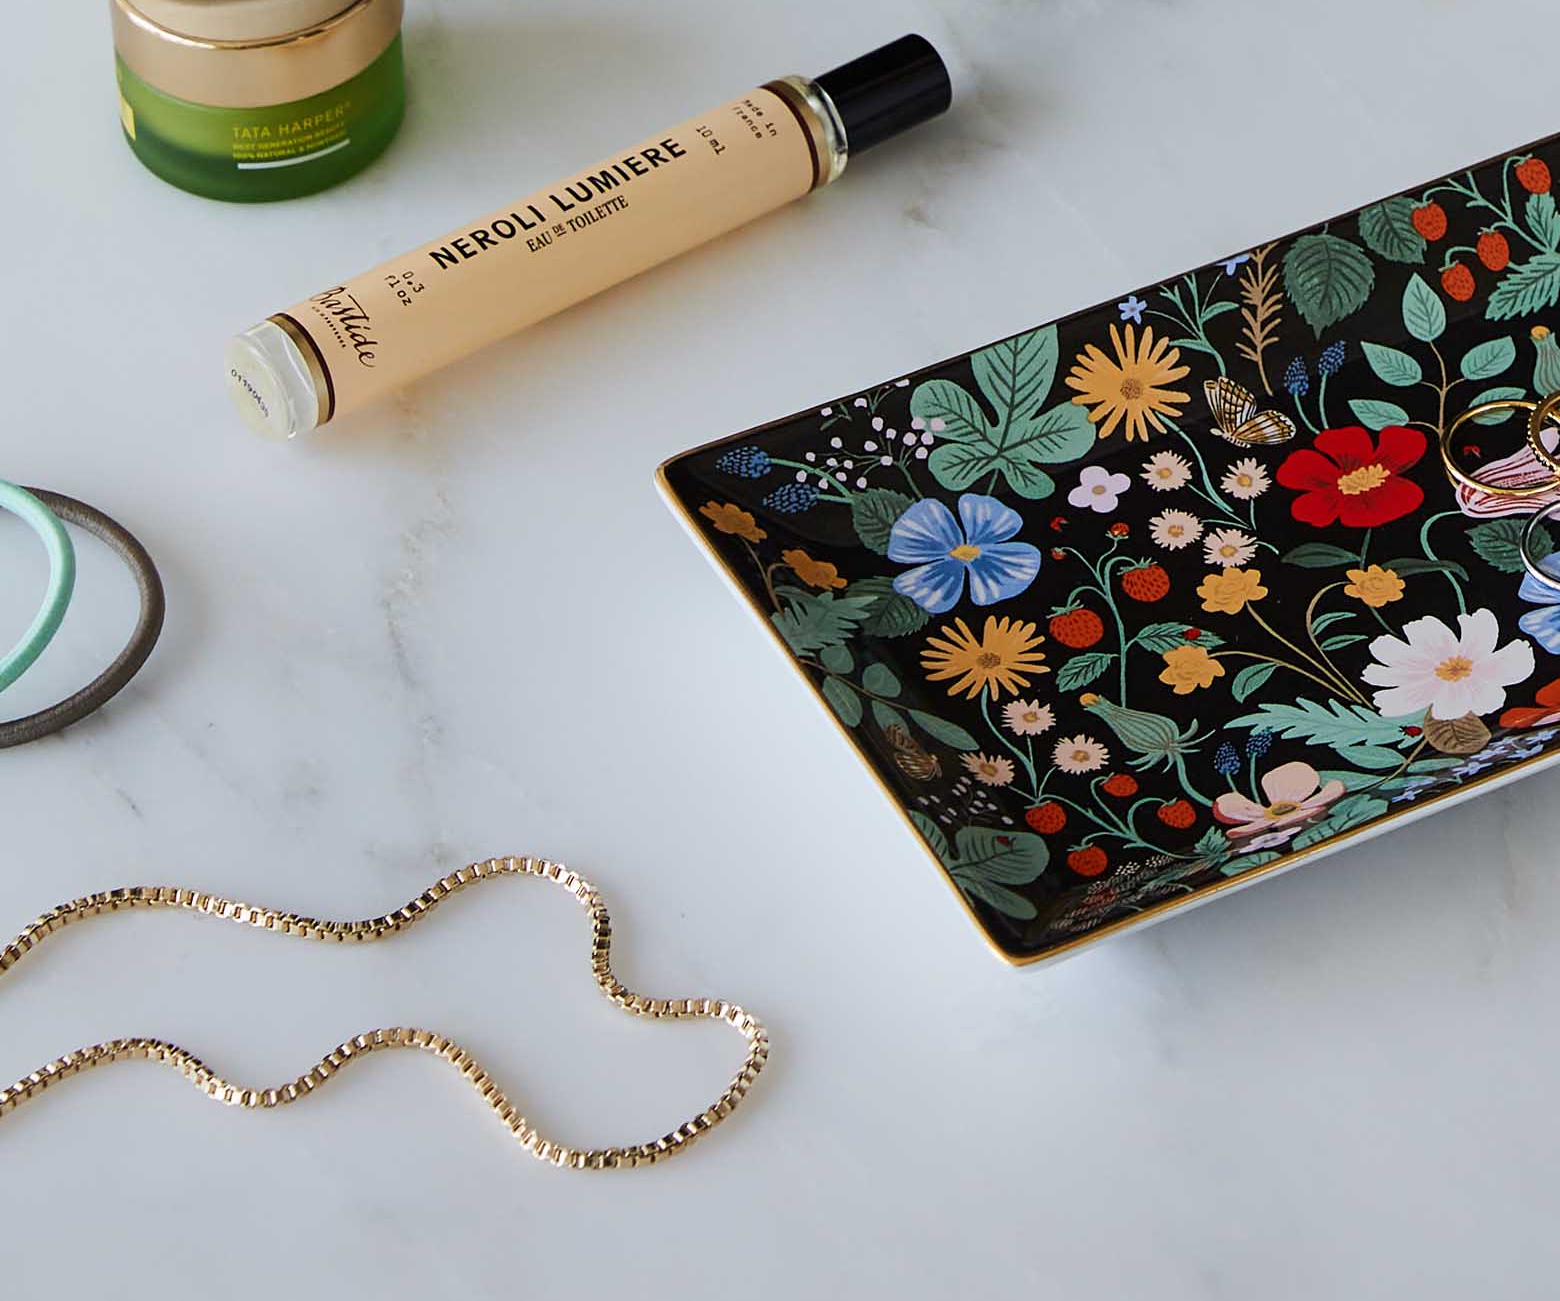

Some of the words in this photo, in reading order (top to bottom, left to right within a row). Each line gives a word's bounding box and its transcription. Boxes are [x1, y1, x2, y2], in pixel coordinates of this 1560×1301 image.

[232, 126, 271, 140] TATA
[696, 125, 713, 138] 10
[709, 138, 726, 155] ml
[429, 205, 547, 271] NEROLI
[549, 138, 688, 212] LUMIERE
[526, 230, 554, 253] EAU
[552, 223, 567, 237] DE
[566, 195, 629, 233] TOILETTE
[402, 270, 425, 294] 0.3
[397, 289, 413, 306] oz
